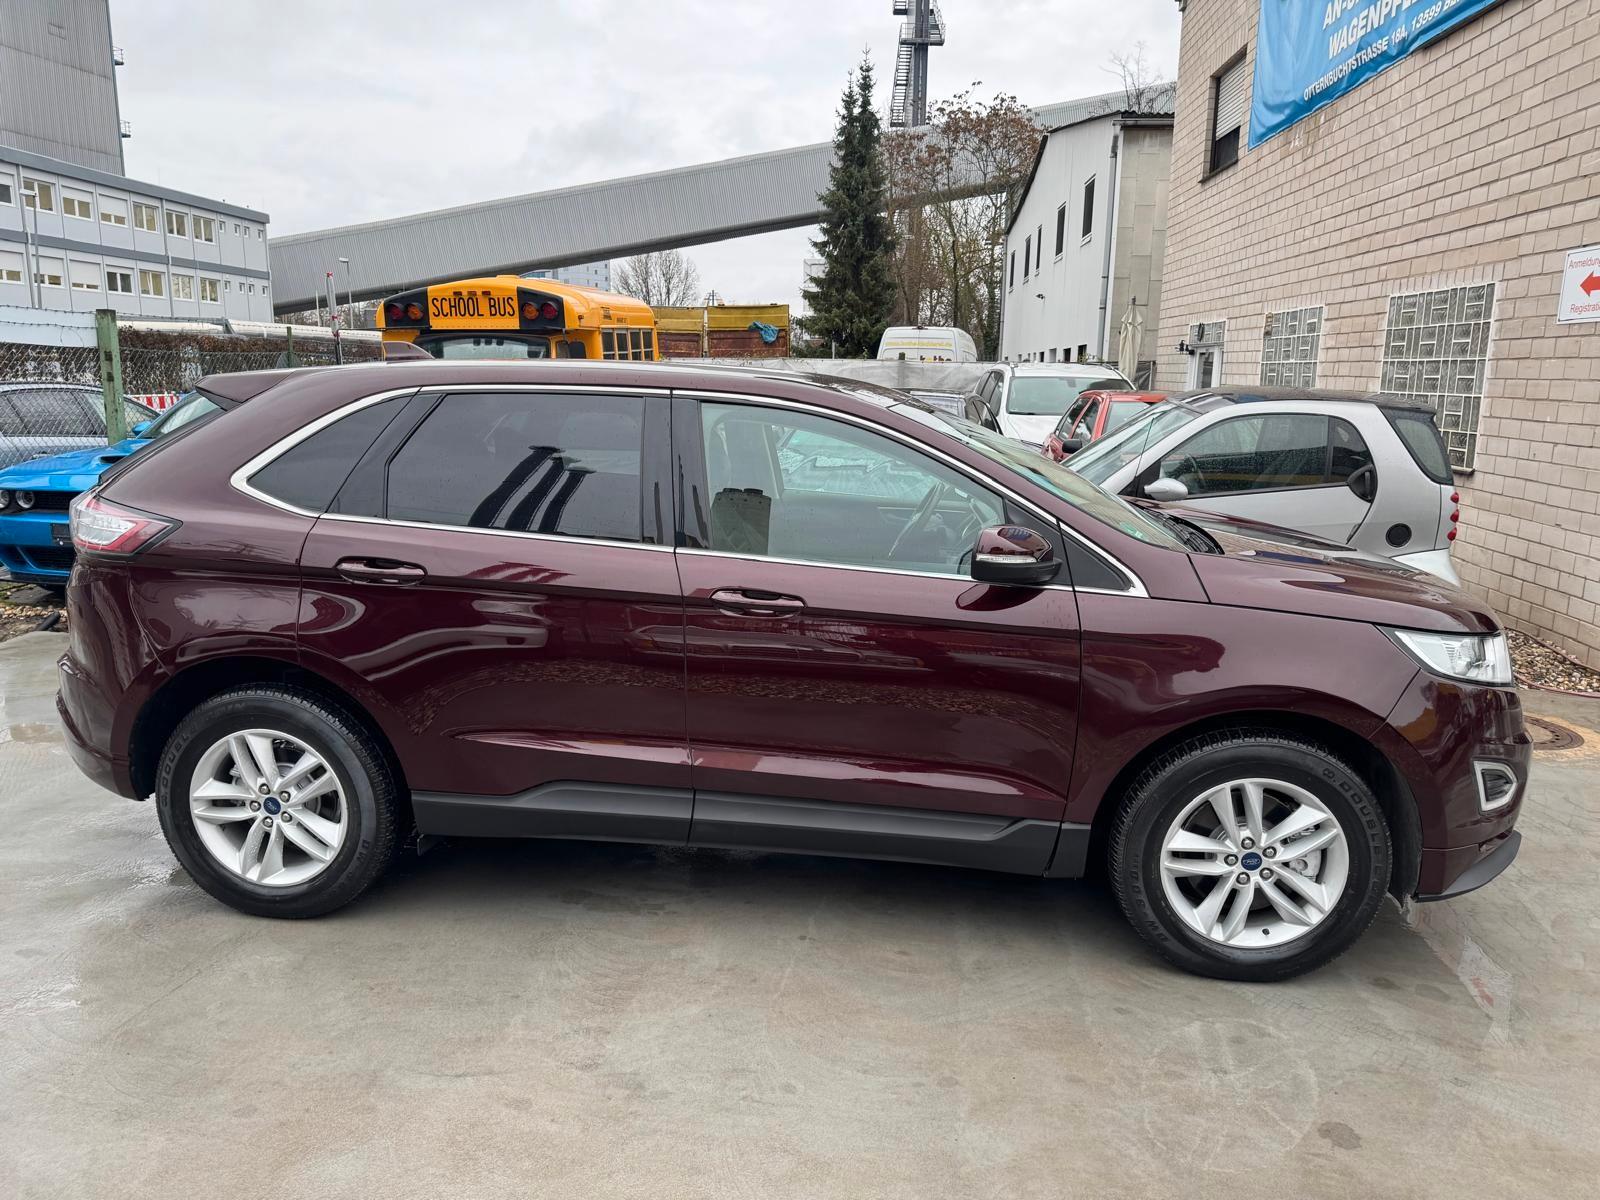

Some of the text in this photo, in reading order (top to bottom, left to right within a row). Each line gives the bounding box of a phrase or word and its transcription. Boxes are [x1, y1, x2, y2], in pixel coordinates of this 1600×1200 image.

[1303, 37, 1389, 101] OTTERNBUCHTSTRASSE
[1411, 1, 1442, 31] 13599
[431, 296, 516, 317] SCHOOL BUS
